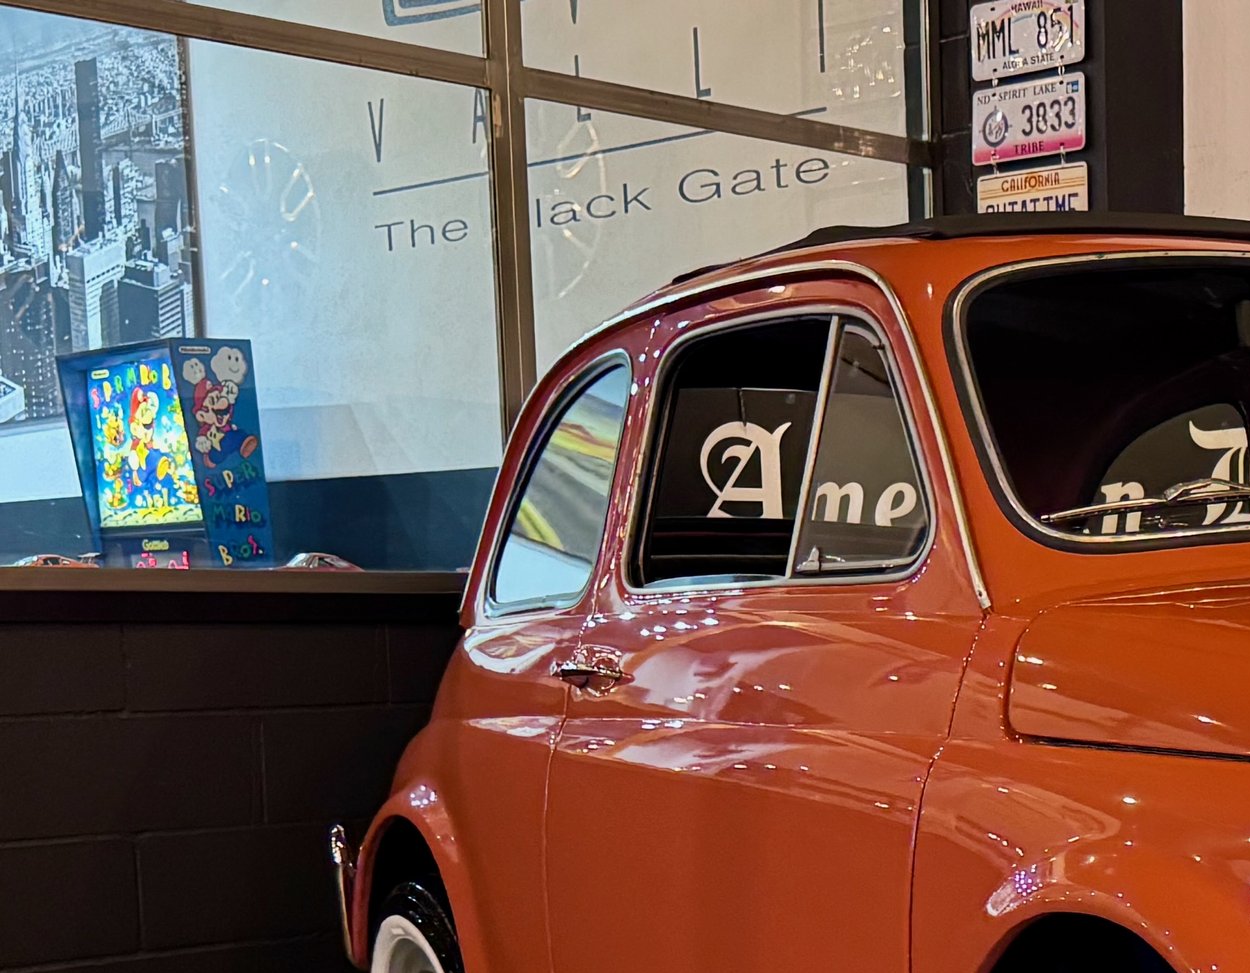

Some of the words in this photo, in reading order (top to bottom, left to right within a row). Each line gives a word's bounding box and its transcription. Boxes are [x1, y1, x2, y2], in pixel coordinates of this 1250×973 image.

[977, 17, 1019, 62] MML
[1037, 5, 1073, 50] 851
[1030, 53, 1054, 65] STATE
[977, 95, 990, 105] ND
[998, 88, 1027, 101] SPIRIT
[1033, 82, 1056, 96] LAKE
[1021, 96, 1076, 136] 3833
[1014, 141, 1045, 155] TRIBE
[1001, 172, 1060, 192] CALIFORNIA
[374, 217, 469, 252] The
[534, 183, 652, 228] lack
[677, 157, 831, 204] Gate
